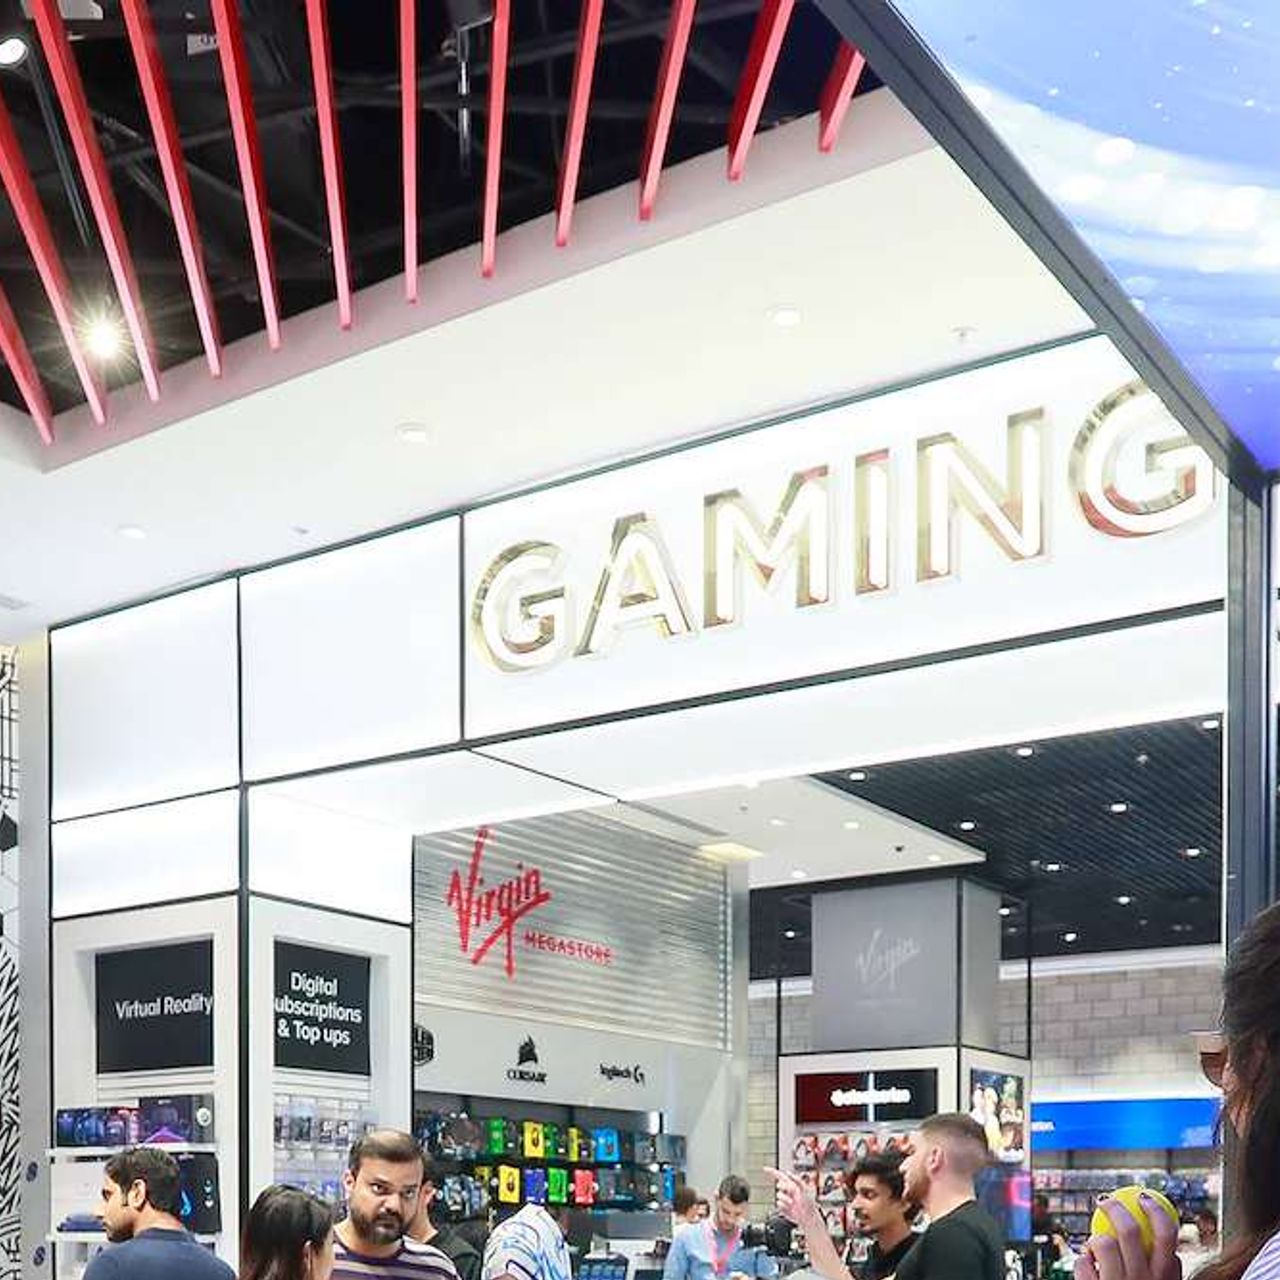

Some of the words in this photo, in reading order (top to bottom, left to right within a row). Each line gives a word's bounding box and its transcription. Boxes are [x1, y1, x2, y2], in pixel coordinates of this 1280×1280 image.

[471, 379, 1219, 672] GAMING
[444, 826, 551, 978] Virgin
[524, 929, 617, 967] MEGASTORE
[291, 972, 338, 998] Digital
[115, 998, 161, 1020] Virtual
[163, 992, 214, 1016] Reality
[273, 995, 363, 1024] ubscriptions
[277, 1019, 290, 1038] &
[293, 1020, 321, 1045] Top
[324, 1028, 351, 1048] ups
